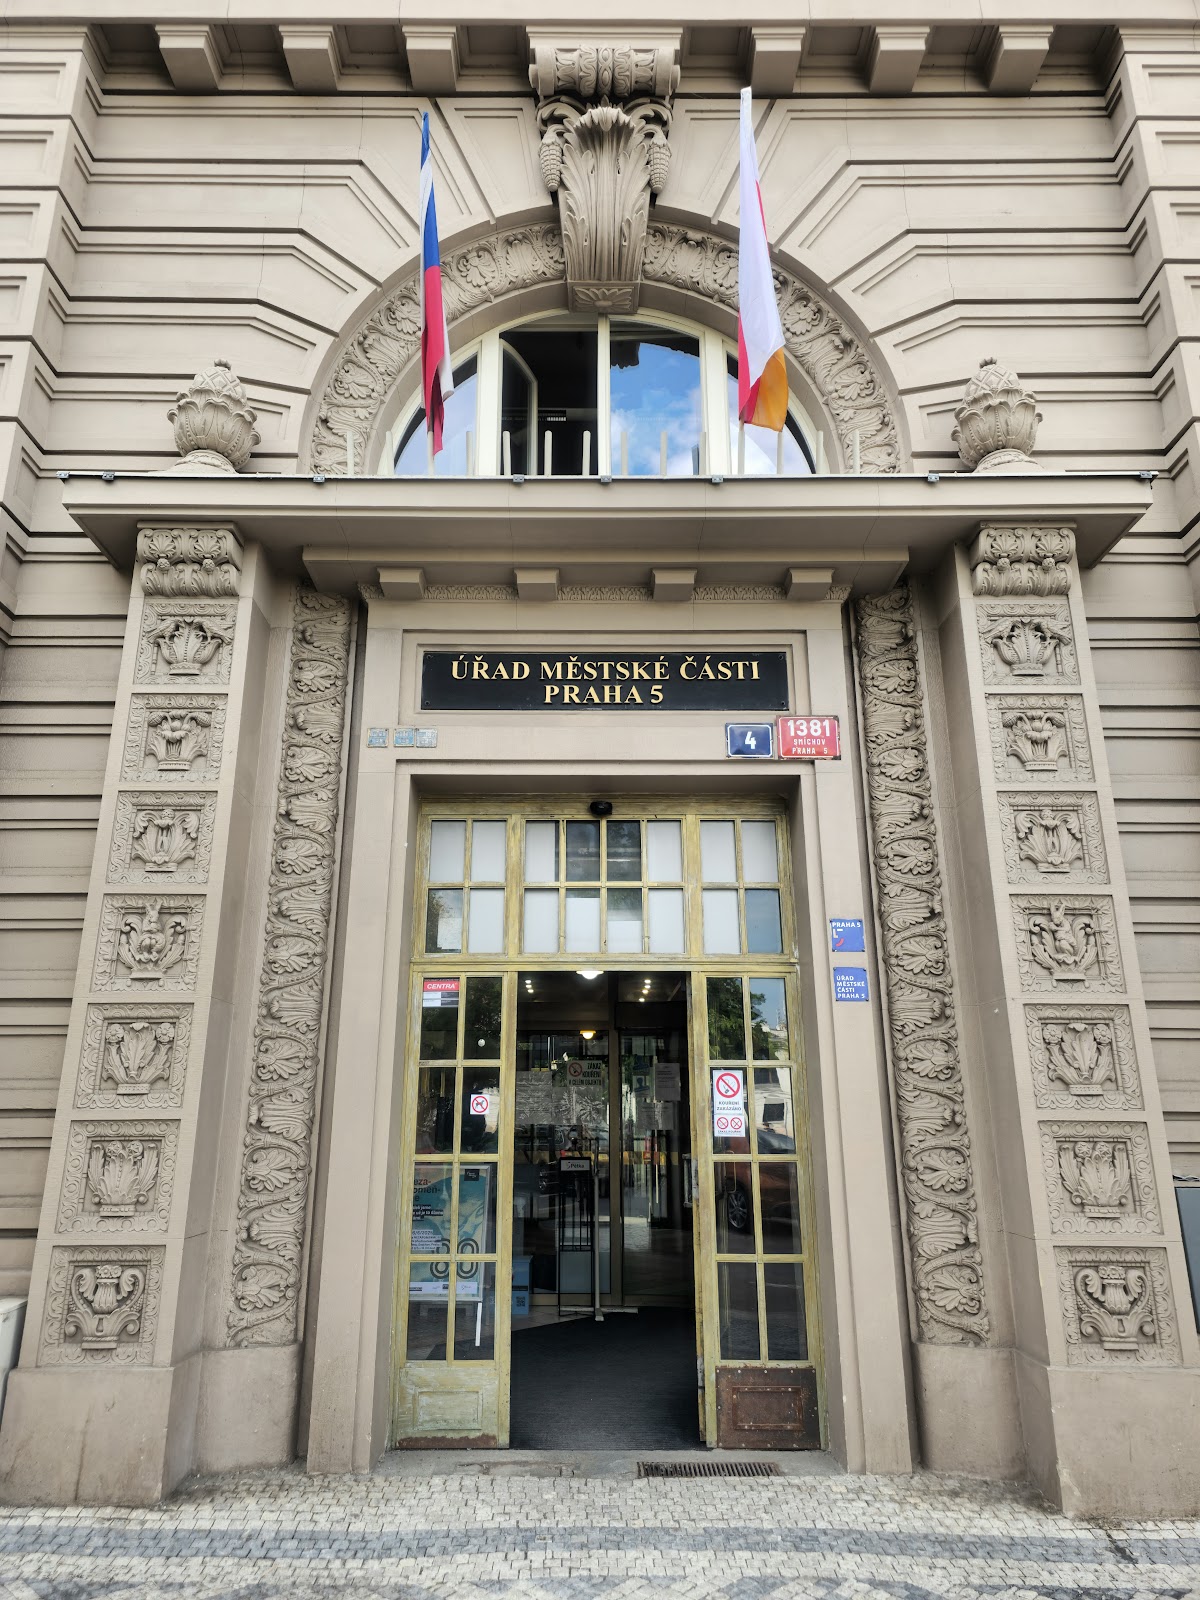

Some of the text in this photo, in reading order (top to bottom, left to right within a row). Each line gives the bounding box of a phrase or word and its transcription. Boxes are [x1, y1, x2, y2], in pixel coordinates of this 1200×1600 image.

[452, 654, 761, 680] ÚŘAD MĚSTSKÉ ČÁSTI
[543, 684, 664, 705] PRAHA 5
[787, 719, 830, 737] 1381
[744, 731, 757, 750] 4
[793, 737, 826, 746] SMÍCHOV
[792, 747, 828, 755] PRAHA 5
